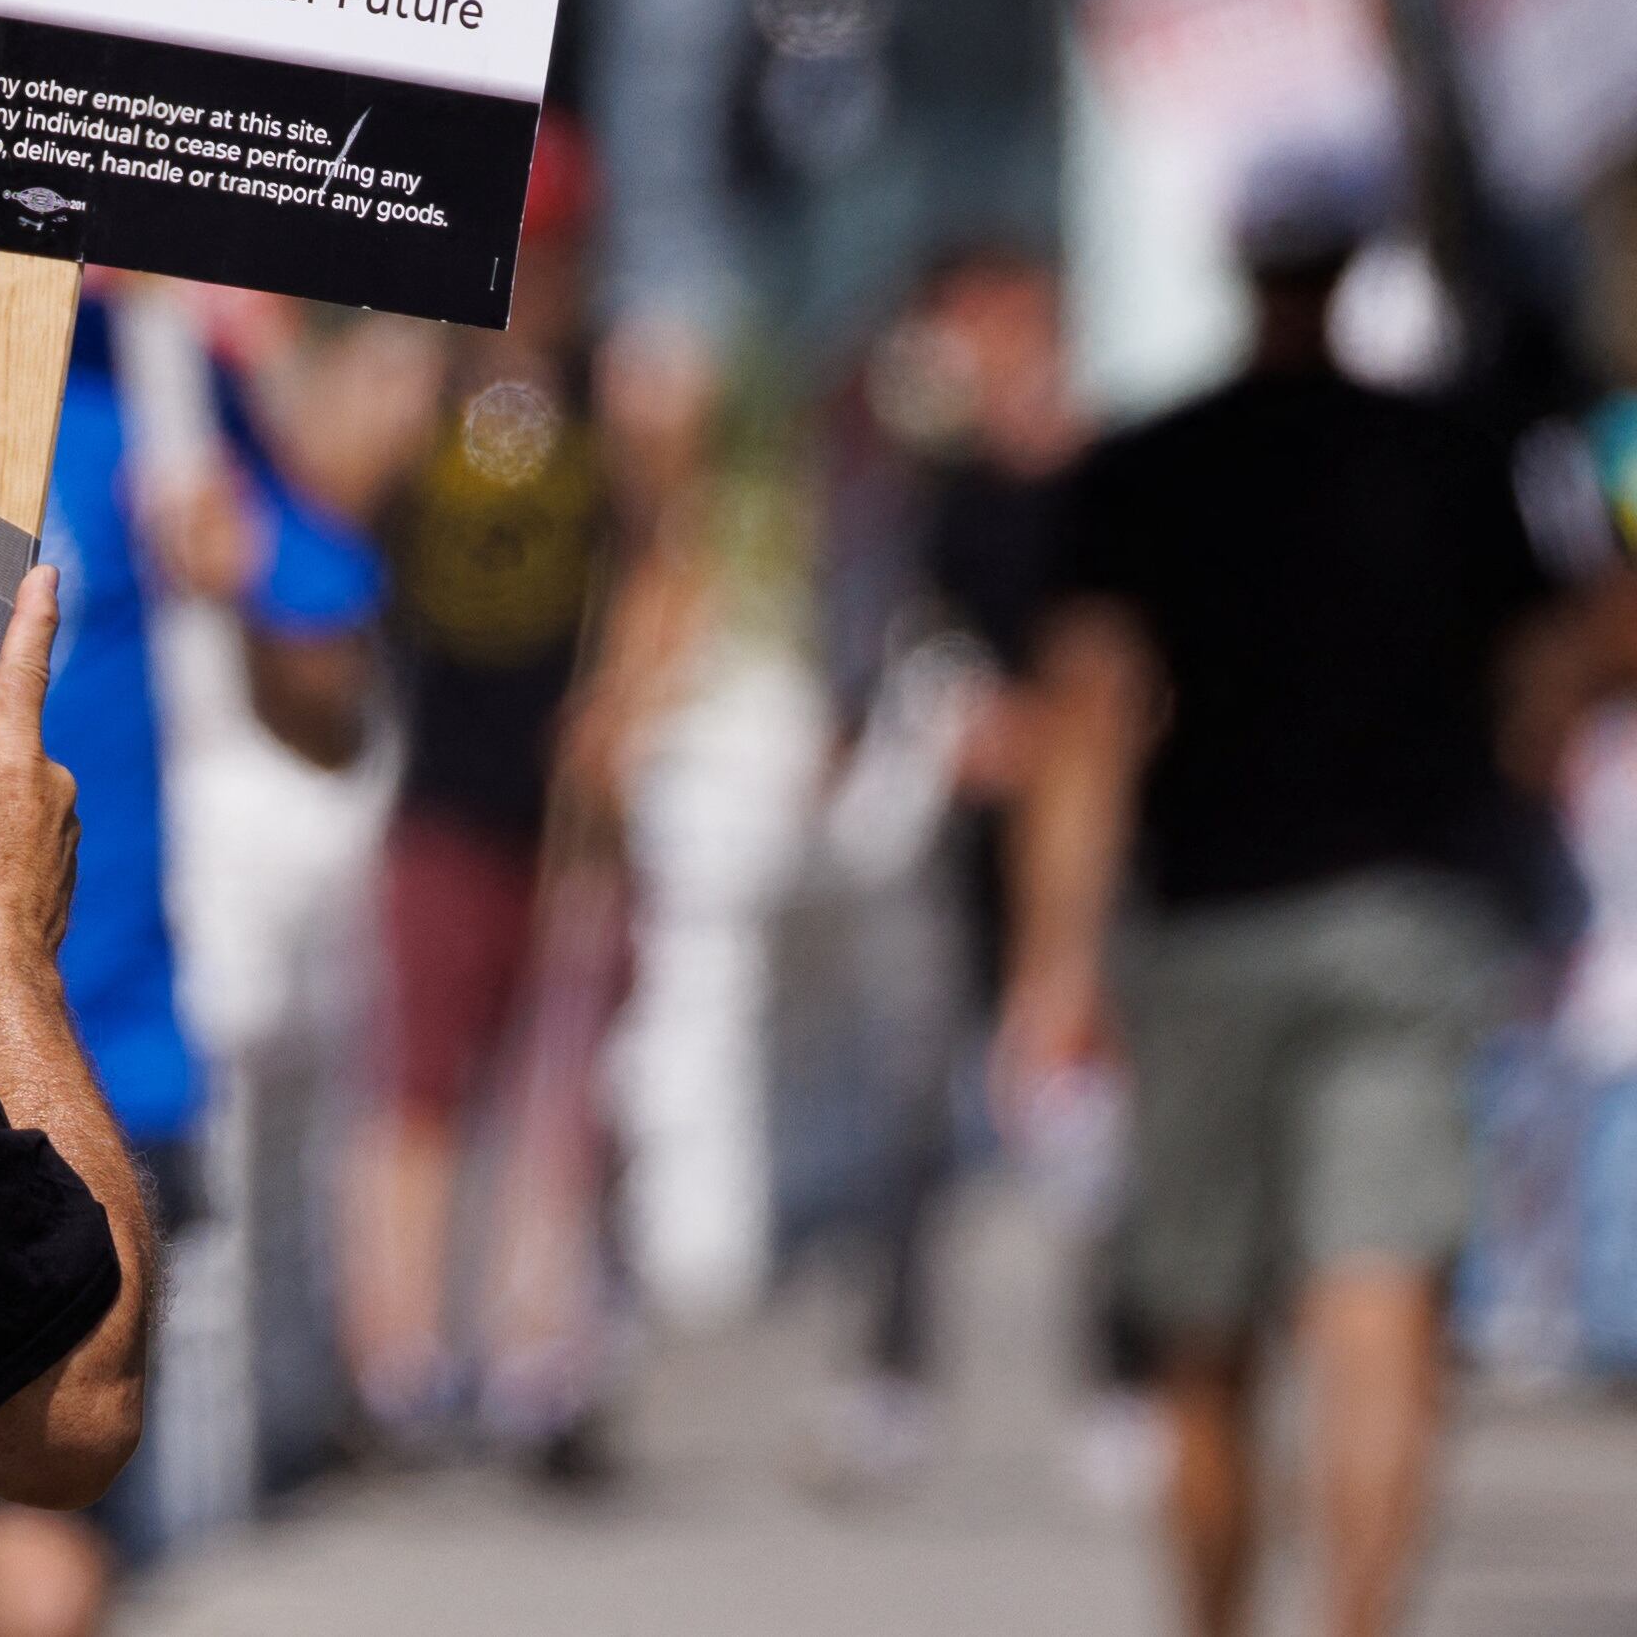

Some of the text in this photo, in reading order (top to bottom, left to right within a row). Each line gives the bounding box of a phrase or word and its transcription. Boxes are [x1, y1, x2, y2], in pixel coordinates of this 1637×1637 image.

[24, 79, 89, 106] other
[92, 92, 206, 126] employer
[209, 109, 234, 130] at
[239, 111, 282, 137] this
[286, 119, 332, 146] site.
[25, 106, 141, 146] individual
[145, 128, 170, 151] to
[174, 136, 242, 162] cease
[245, 147, 375, 190] performing
[380, 169, 422, 196] any
[12, 137, 95, 173] deliver,
[101, 149, 184, 184] handle
[188, 169, 215, 188] or
[218, 171, 327, 209] transport
[331, 192, 373, 219] any
[376, 200, 448, 228] goods.
